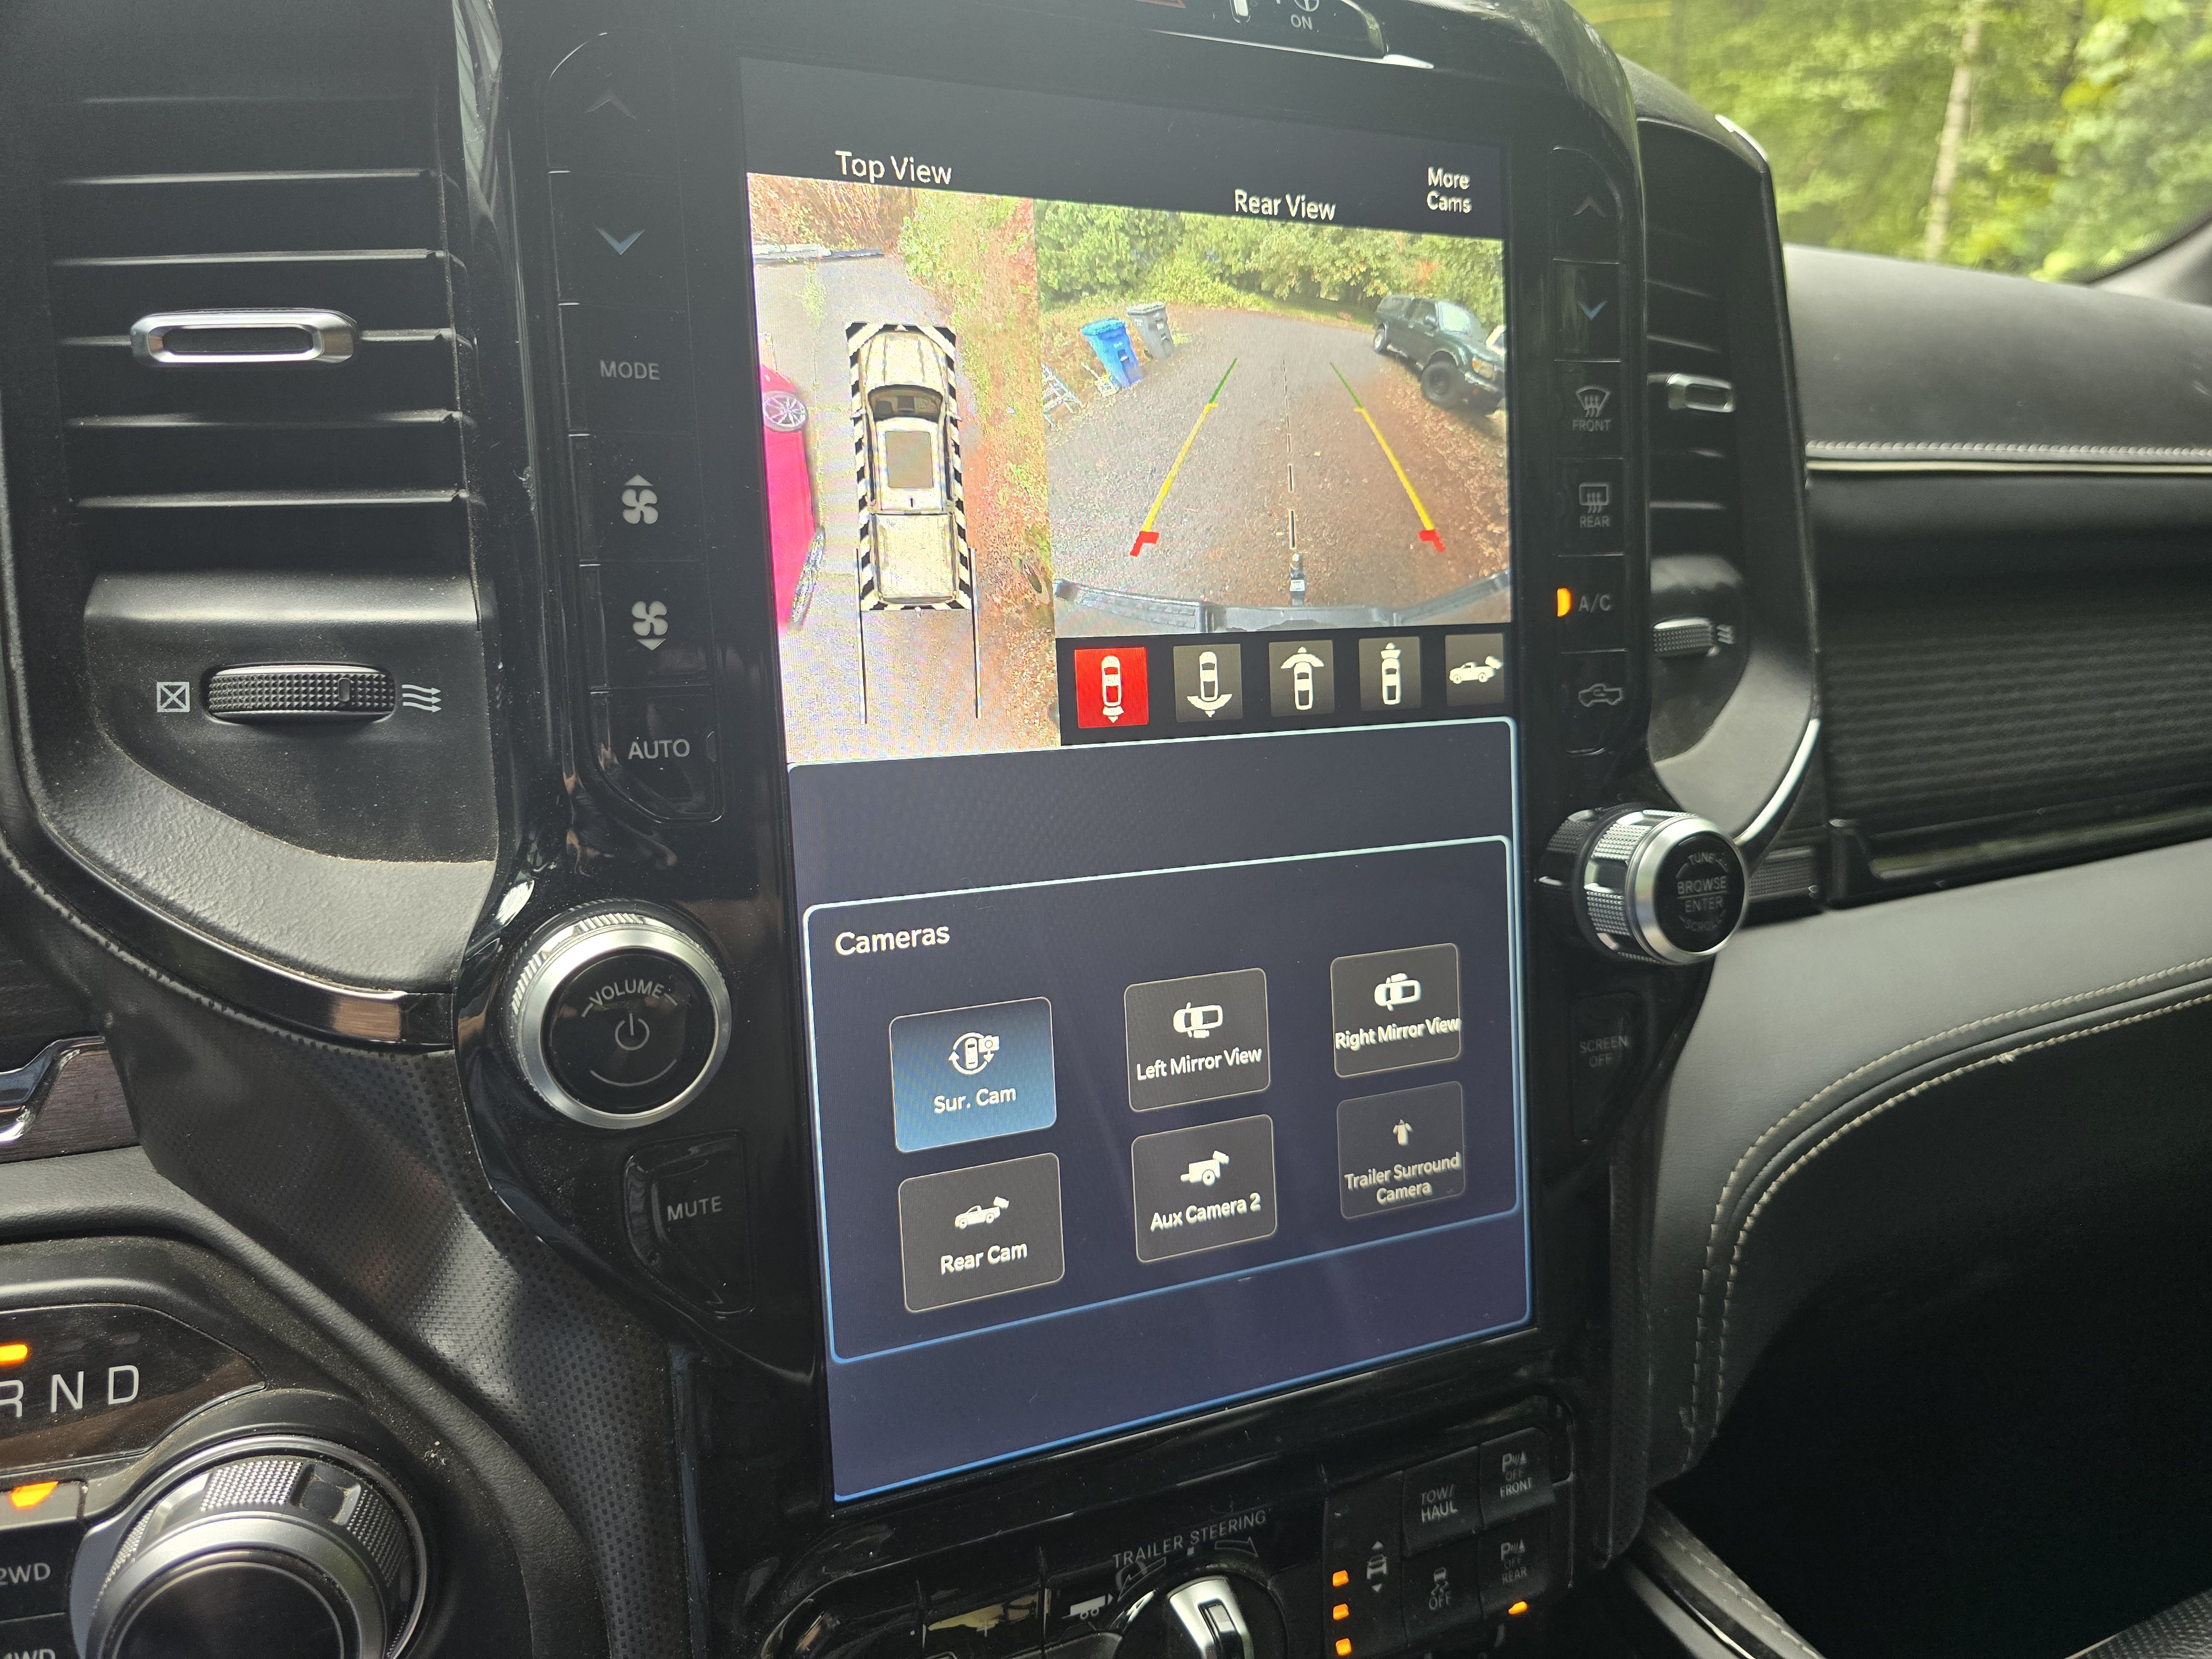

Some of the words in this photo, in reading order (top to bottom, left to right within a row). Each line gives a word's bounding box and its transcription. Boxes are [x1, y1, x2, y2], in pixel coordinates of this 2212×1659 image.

[1291, 14, 1312, 30] ON
[835, 150, 885, 183] Top
[890, 156, 952, 185] View
[1427, 166, 1470, 190] More
[1234, 189, 1282, 216] Rear
[1285, 194, 1335, 221] View
[1426, 190, 1472, 214] Cams
[600, 359, 660, 380] MODE
[1573, 419, 1611, 432] FRONT
[1579, 515, 1610, 528] REAR
[1578, 593, 1611, 613] A/C
[628, 738, 690, 760] AUTO
[1687, 852, 1715, 866] TUNE
[1677, 875, 1727, 894] BROWSE
[1684, 896, 1723, 913] ENTER
[834, 925, 951, 956] Cameras
[588, 979, 665, 1006] VOLUME
[1334, 1027, 1376, 1051] Right
[1378, 1022, 1425, 1044] Mirror
[1426, 1016, 1461, 1035] View
[1579, 1035, 1630, 1054] SCREEN
[1136, 1059, 1166, 1081] Left
[1170, 1053, 1222, 1075] Mirror
[1225, 1047, 1262, 1066] View
[1589, 1053, 1613, 1068] OFF
[933, 1093, 972, 1114] Sur.
[977, 1085, 1017, 1106] Cam
[1344, 1169, 1391, 1191] Trailer
[1393, 1152, 1462, 1181] Surround
[1375, 1181, 1432, 1205] Camera
[667, 1196, 722, 1222] MUTE
[1150, 1211, 1182, 1232] Aux
[1185, 1198, 1246, 1225] Camera
[1248, 1192, 1262, 1213] 2
[940, 1251, 984, 1274] Rear
[987, 1243, 1028, 1265] Cam
[0, 1380, 24, 1417] R
[50, 1371, 84, 1413] N
[108, 1365, 139, 1405] D
[1500, 1477, 1532, 1499] FRONT
[1421, 1500, 1458, 1524] HAUL
[1113, 1534, 1183, 1568] TRAILER
[1190, 1509, 1266, 1545] STEERING
[0, 1563, 51, 1586] 2WD
[1502, 1568, 1527, 1584] REAR
[1429, 1592, 1453, 1611] OFF
